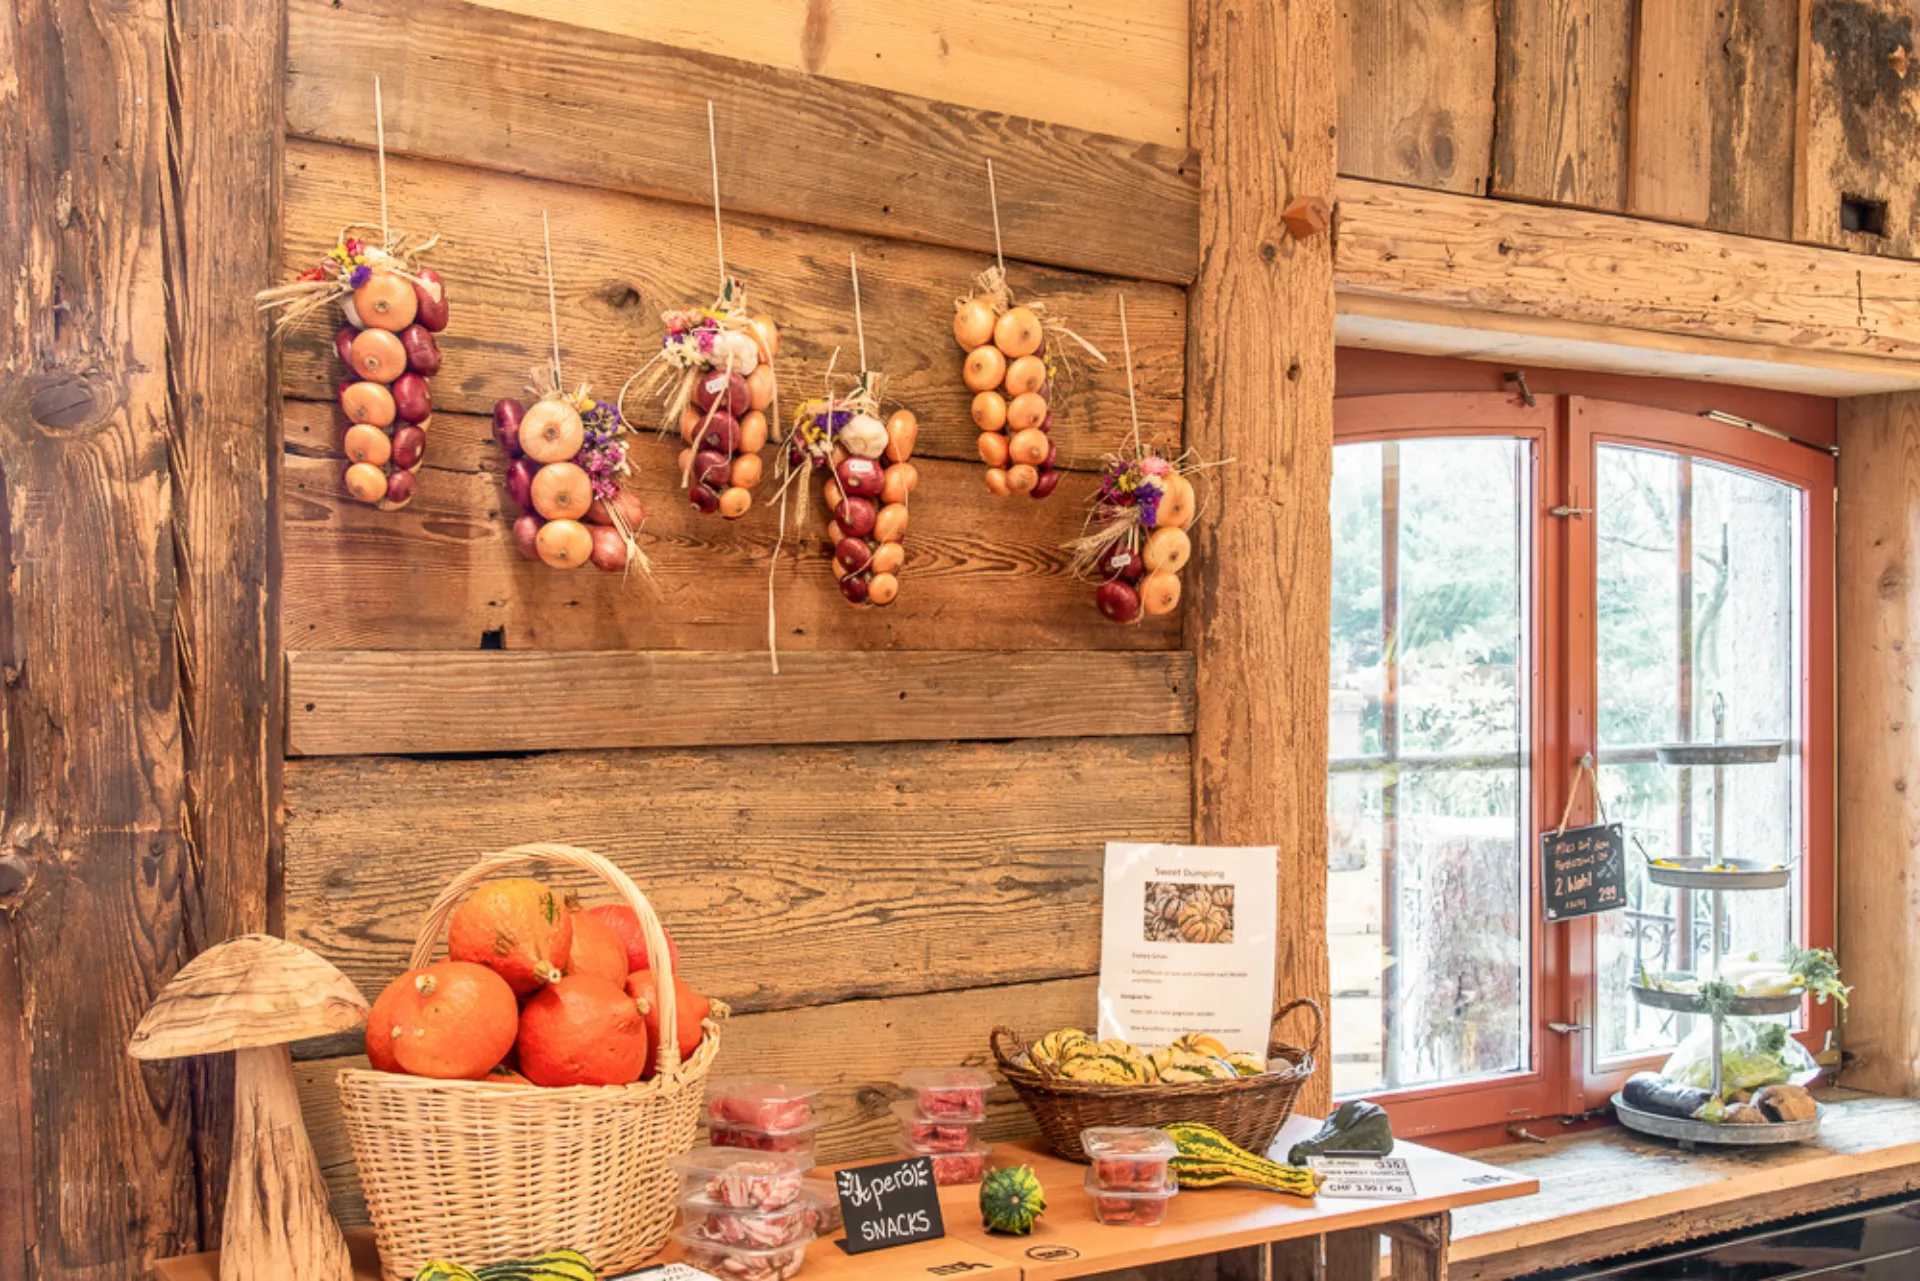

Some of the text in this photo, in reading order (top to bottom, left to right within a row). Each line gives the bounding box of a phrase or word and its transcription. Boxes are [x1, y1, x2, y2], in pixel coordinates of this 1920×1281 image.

[1155, 867, 1225, 879] Sweet Dumpling
[1567, 871, 1592, 893] Wahl
[1328, 1184, 1351, 1192] CHF
[861, 1209, 931, 1241] SNACKS
